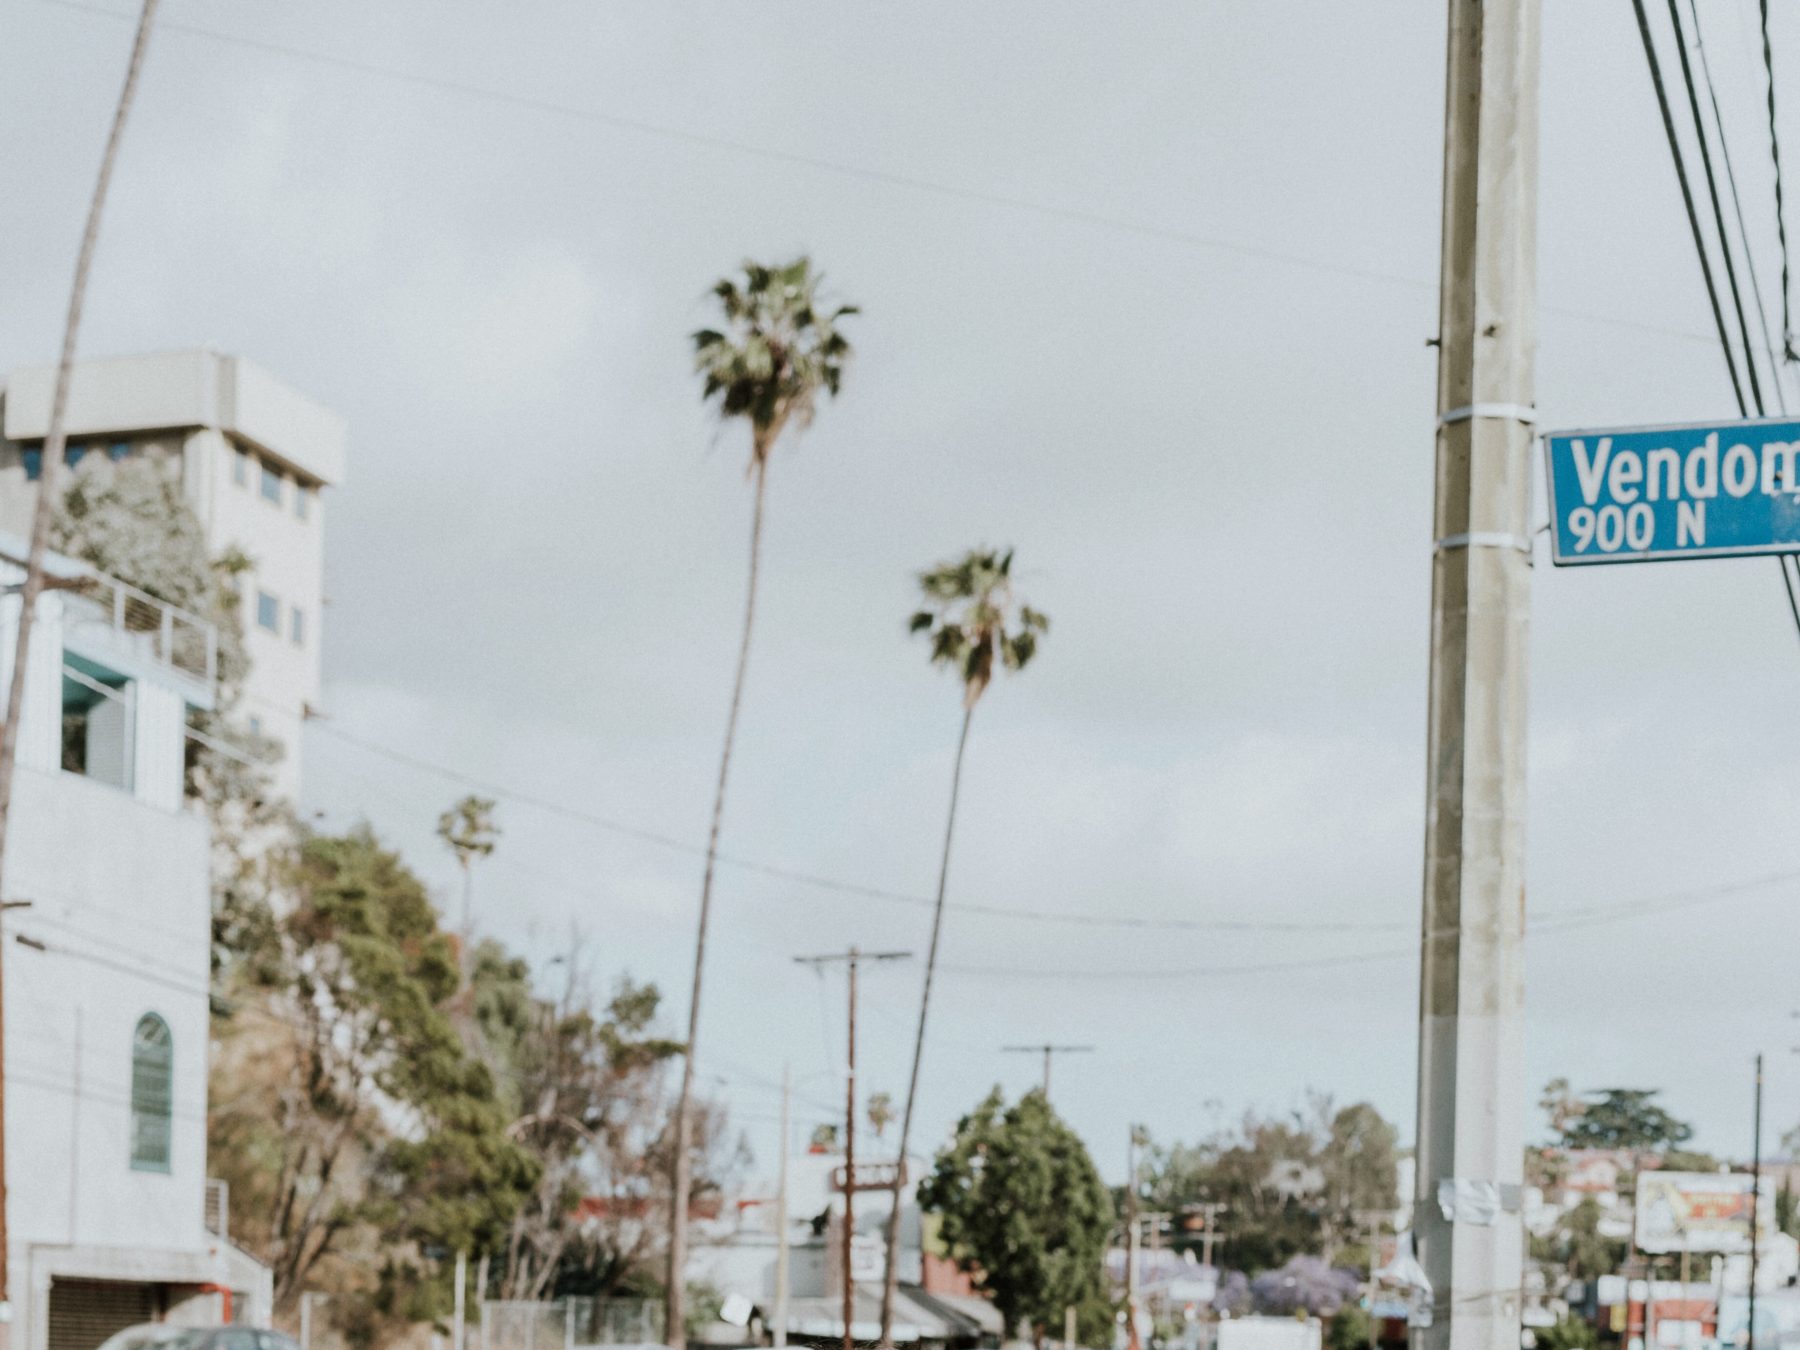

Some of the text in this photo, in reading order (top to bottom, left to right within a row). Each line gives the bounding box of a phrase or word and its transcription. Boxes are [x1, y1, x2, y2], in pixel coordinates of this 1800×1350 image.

[1571, 432, 1800, 505] Vendom
[1568, 500, 1706, 553] 900 N
